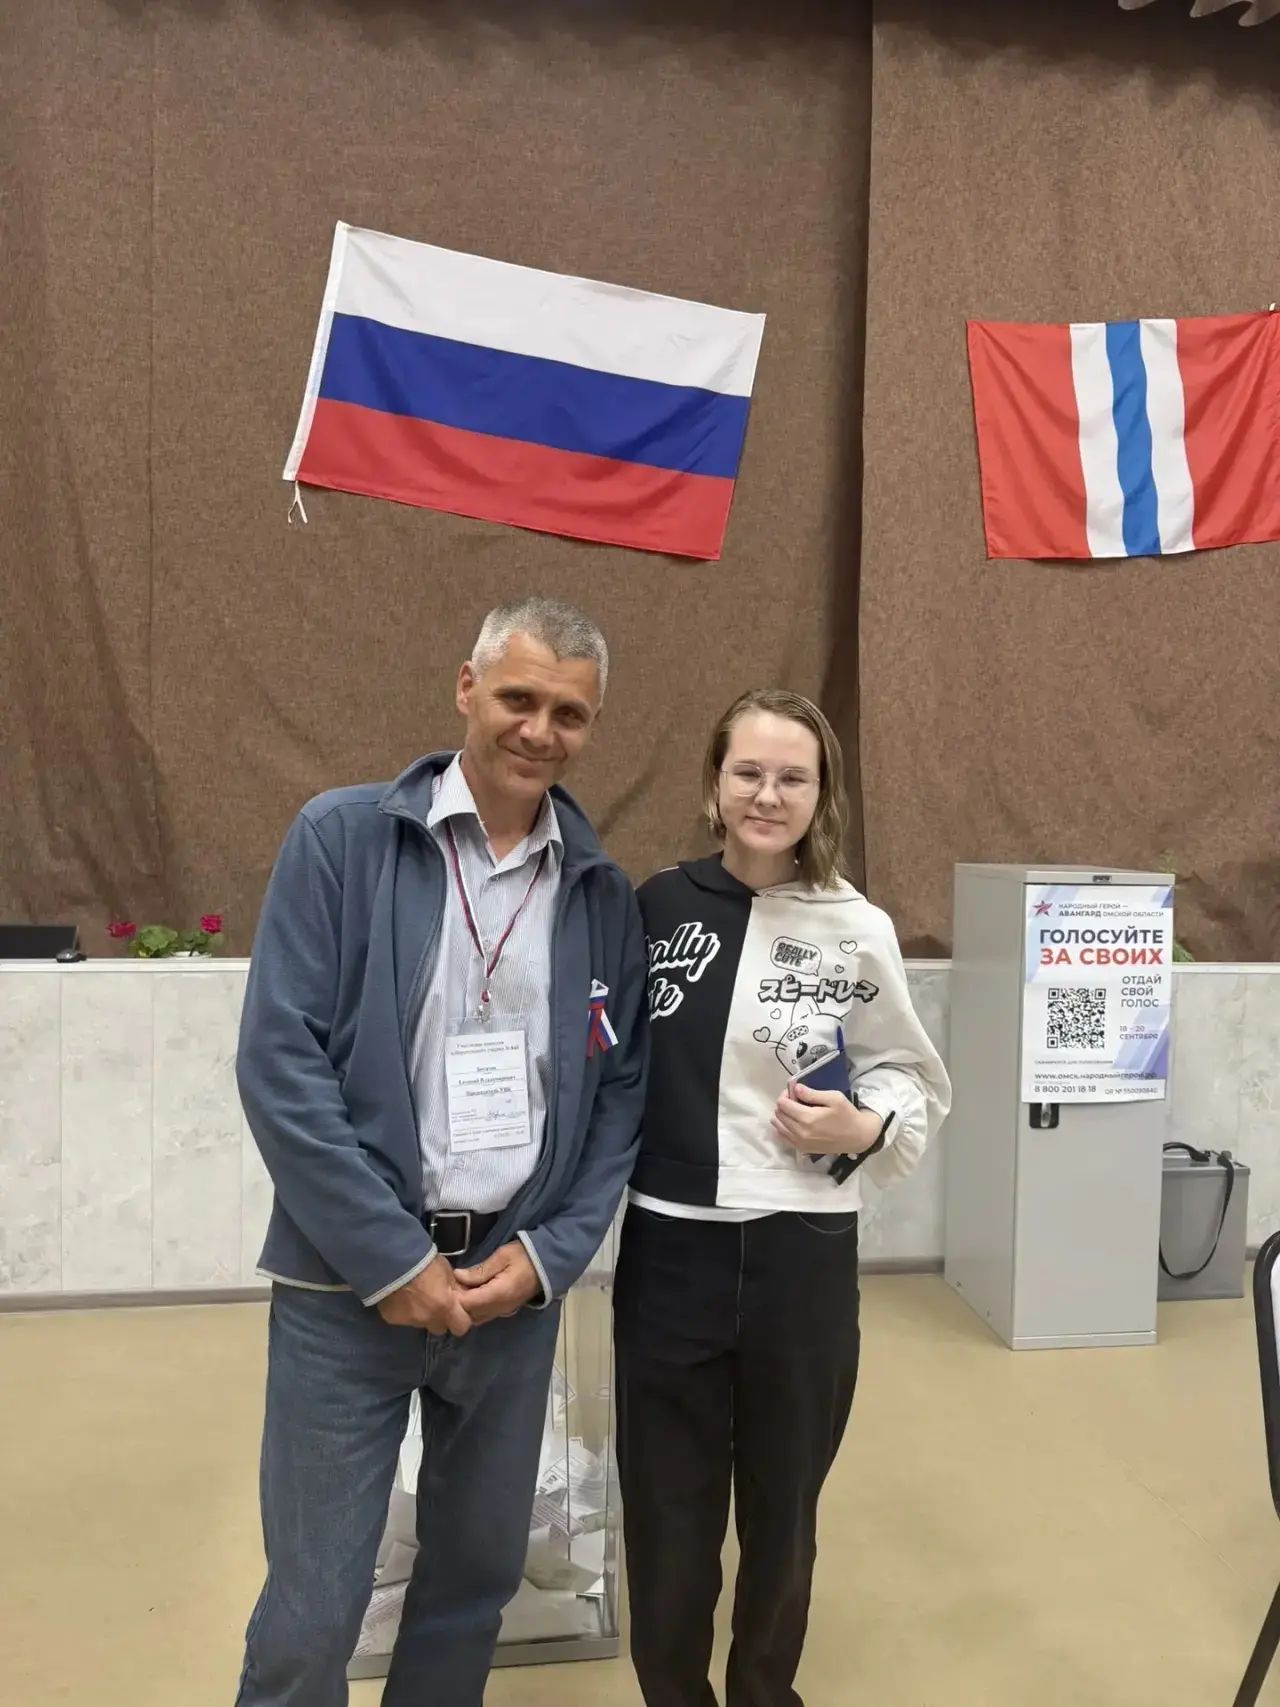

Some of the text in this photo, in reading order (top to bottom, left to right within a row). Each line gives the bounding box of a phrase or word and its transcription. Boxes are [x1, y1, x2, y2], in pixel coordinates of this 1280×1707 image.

[1058, 902, 1097, 910] НАРОДНЫЙ
[1058, 910, 1102, 918] АВАНГАРД
[1040, 925, 1164, 944] ГОЛОСУЙТЕ
[648, 921, 721, 983] ally
[776, 942, 818, 961] REALLY
[1040, 948, 1163, 965] ЗА СВОИХ
[774, 952, 804, 967] CUTE
[1122, 973, 1162, 985] ОТДАЙ
[1121, 985, 1153, 996] СВОЙ
[1120, 998, 1160, 1008] ГОЛОС
[1034, 1085, 1096, 1093] 8 800 201 18 18
